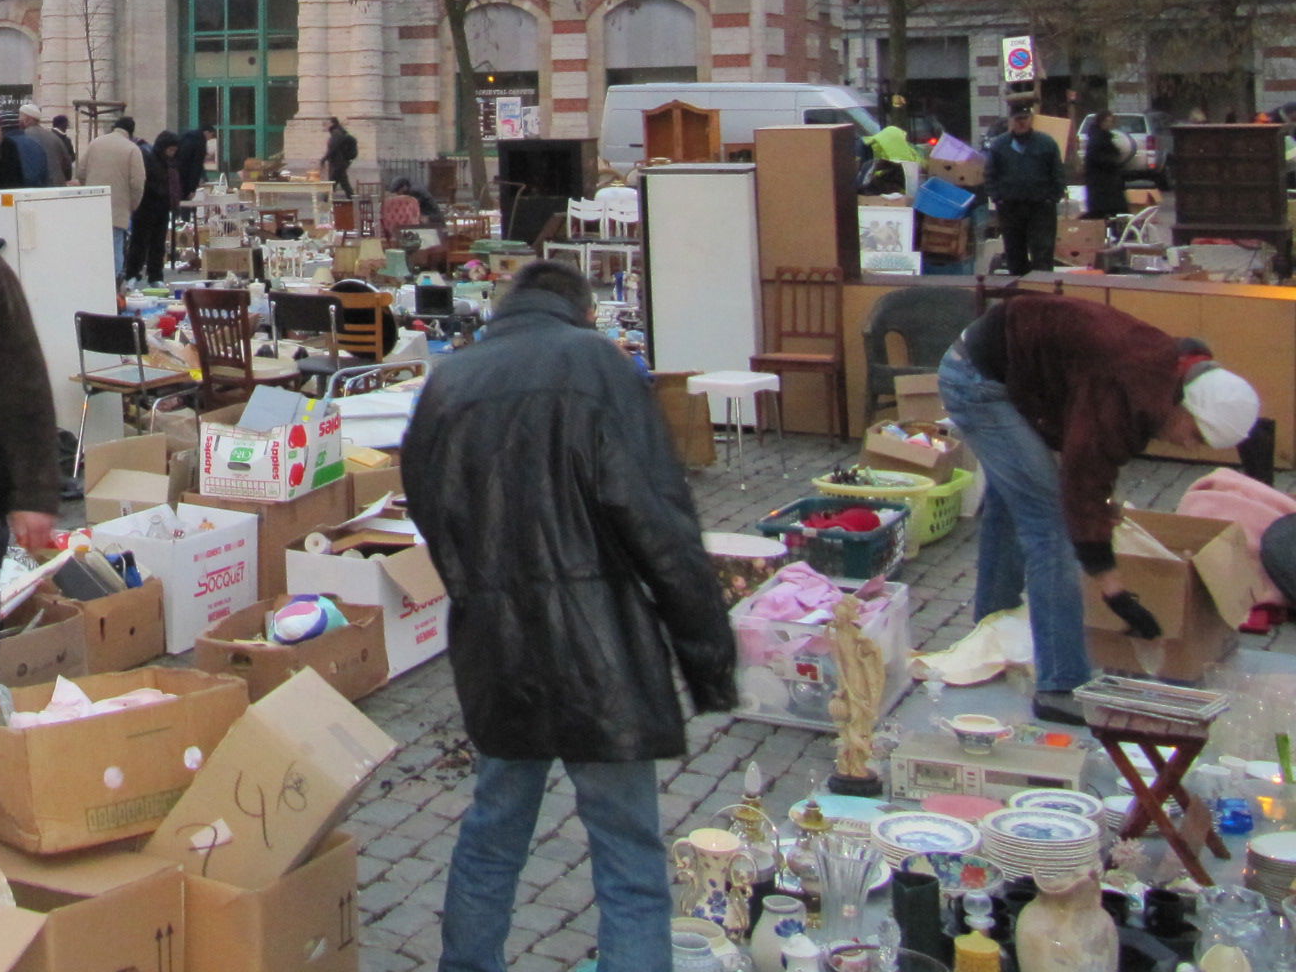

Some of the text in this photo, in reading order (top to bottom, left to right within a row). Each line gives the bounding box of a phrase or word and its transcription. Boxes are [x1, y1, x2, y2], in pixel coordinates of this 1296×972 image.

[204, 435, 213, 475] Apples
[271, 440, 280, 480] Apples
[194, 561, 246, 598] SOCQUET
